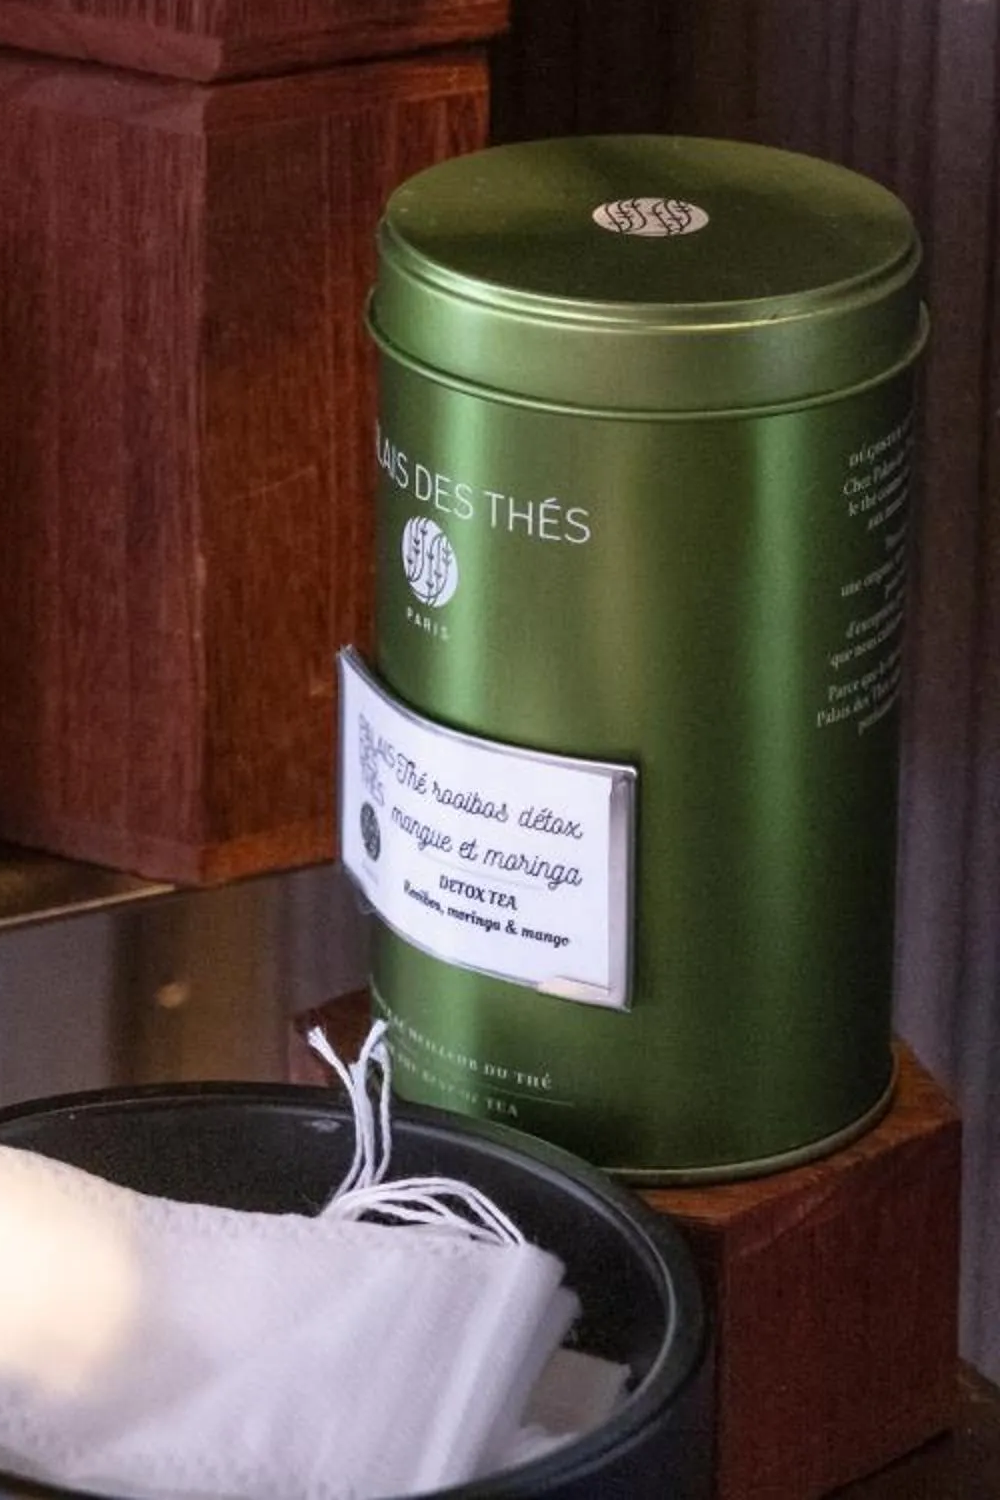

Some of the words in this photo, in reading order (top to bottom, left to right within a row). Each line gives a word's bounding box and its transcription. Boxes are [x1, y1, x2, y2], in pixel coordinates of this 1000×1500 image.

[415, 463, 474, 520] DES
[483, 490, 592, 544] THÉS
[406, 606, 449, 641] PARIS
[396, 752, 427, 795] Thé
[431, 780, 509, 823] rooibos
[518, 806, 585, 840] détox
[391, 806, 453, 852] mangue
[459, 838, 479, 861] et
[483, 848, 583, 891] moringa
[439, 874, 485, 904] DETOX
[489, 891, 518, 911] TEA
[447, 905, 501, 933] moringa
[505, 920, 518, 936] &
[521, 927, 570, 949] mango
[514, 1070, 553, 1090] THÉ
